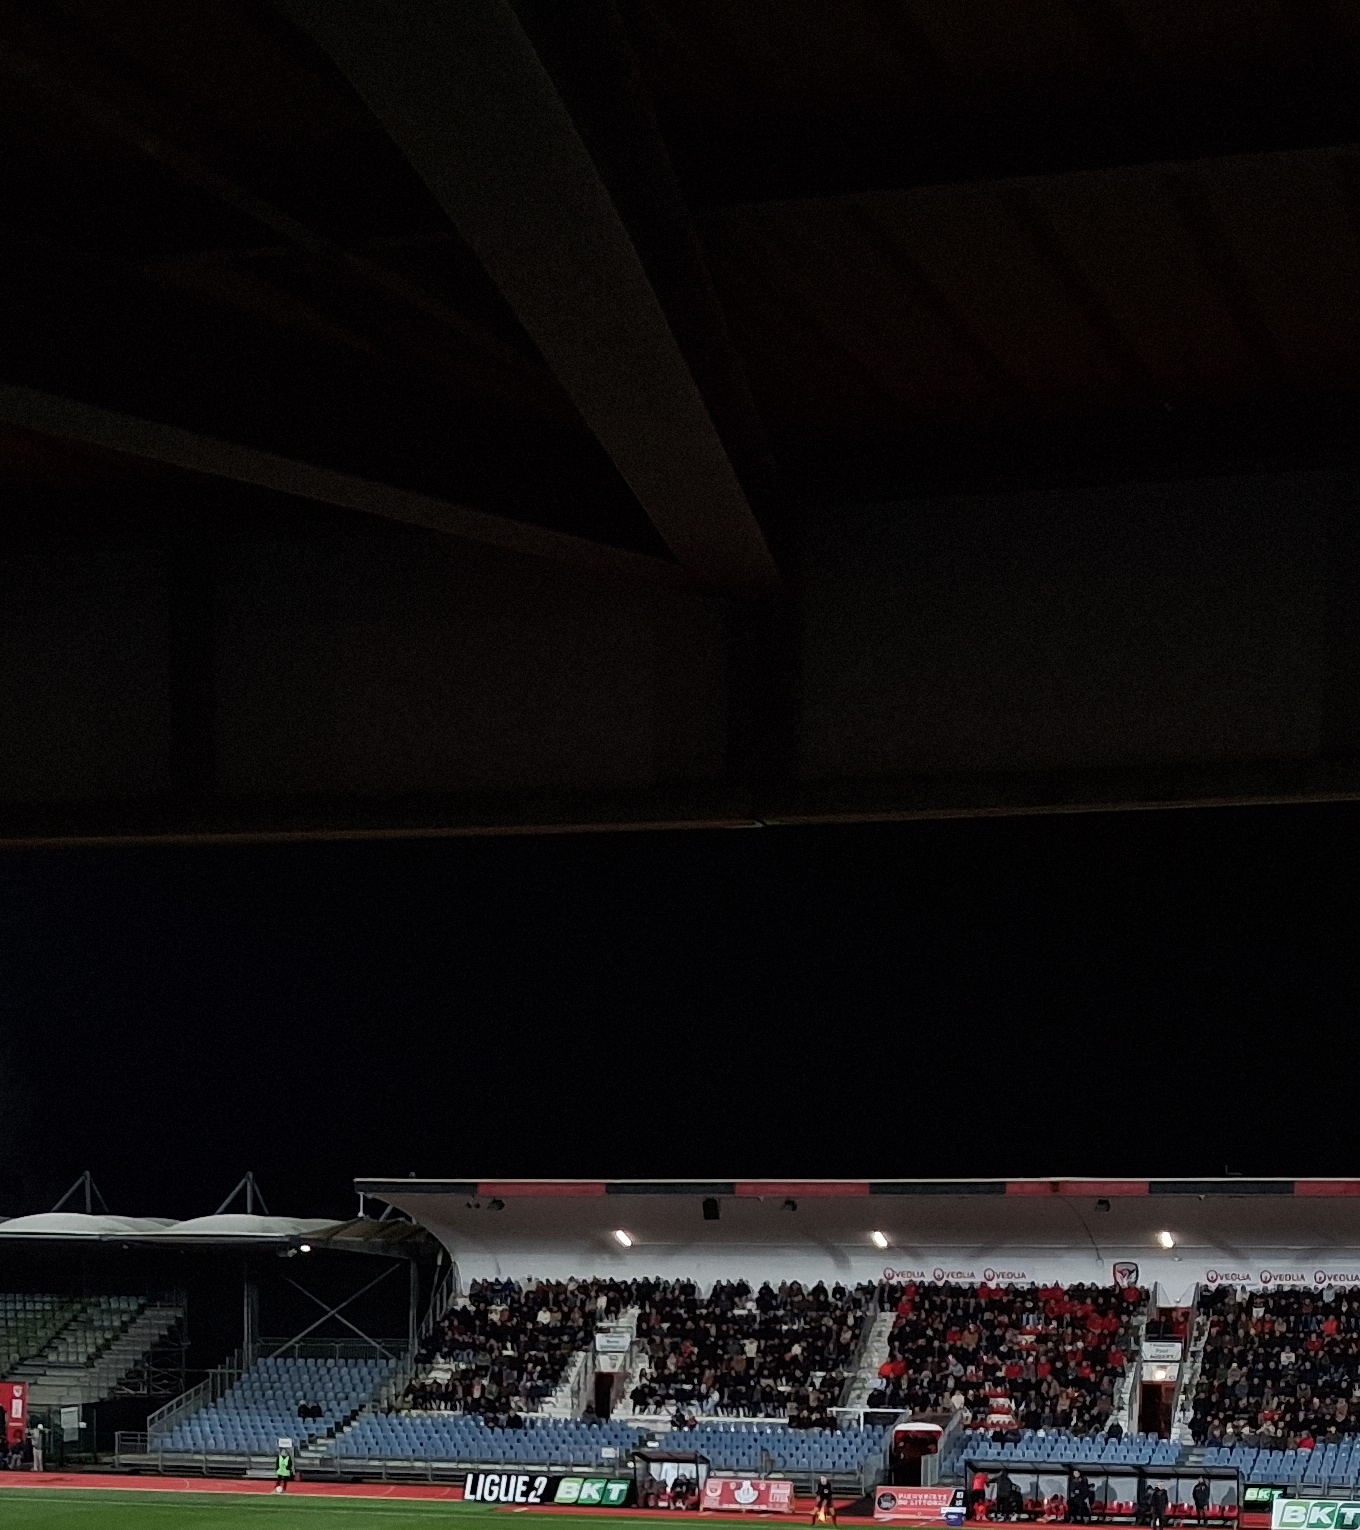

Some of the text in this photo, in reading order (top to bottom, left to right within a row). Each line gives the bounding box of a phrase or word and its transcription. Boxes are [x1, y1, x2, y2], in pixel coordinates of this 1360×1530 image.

[464, 1473, 630, 1503] LIGUE 2 BKT
[1245, 1488, 1283, 1500] BKT
